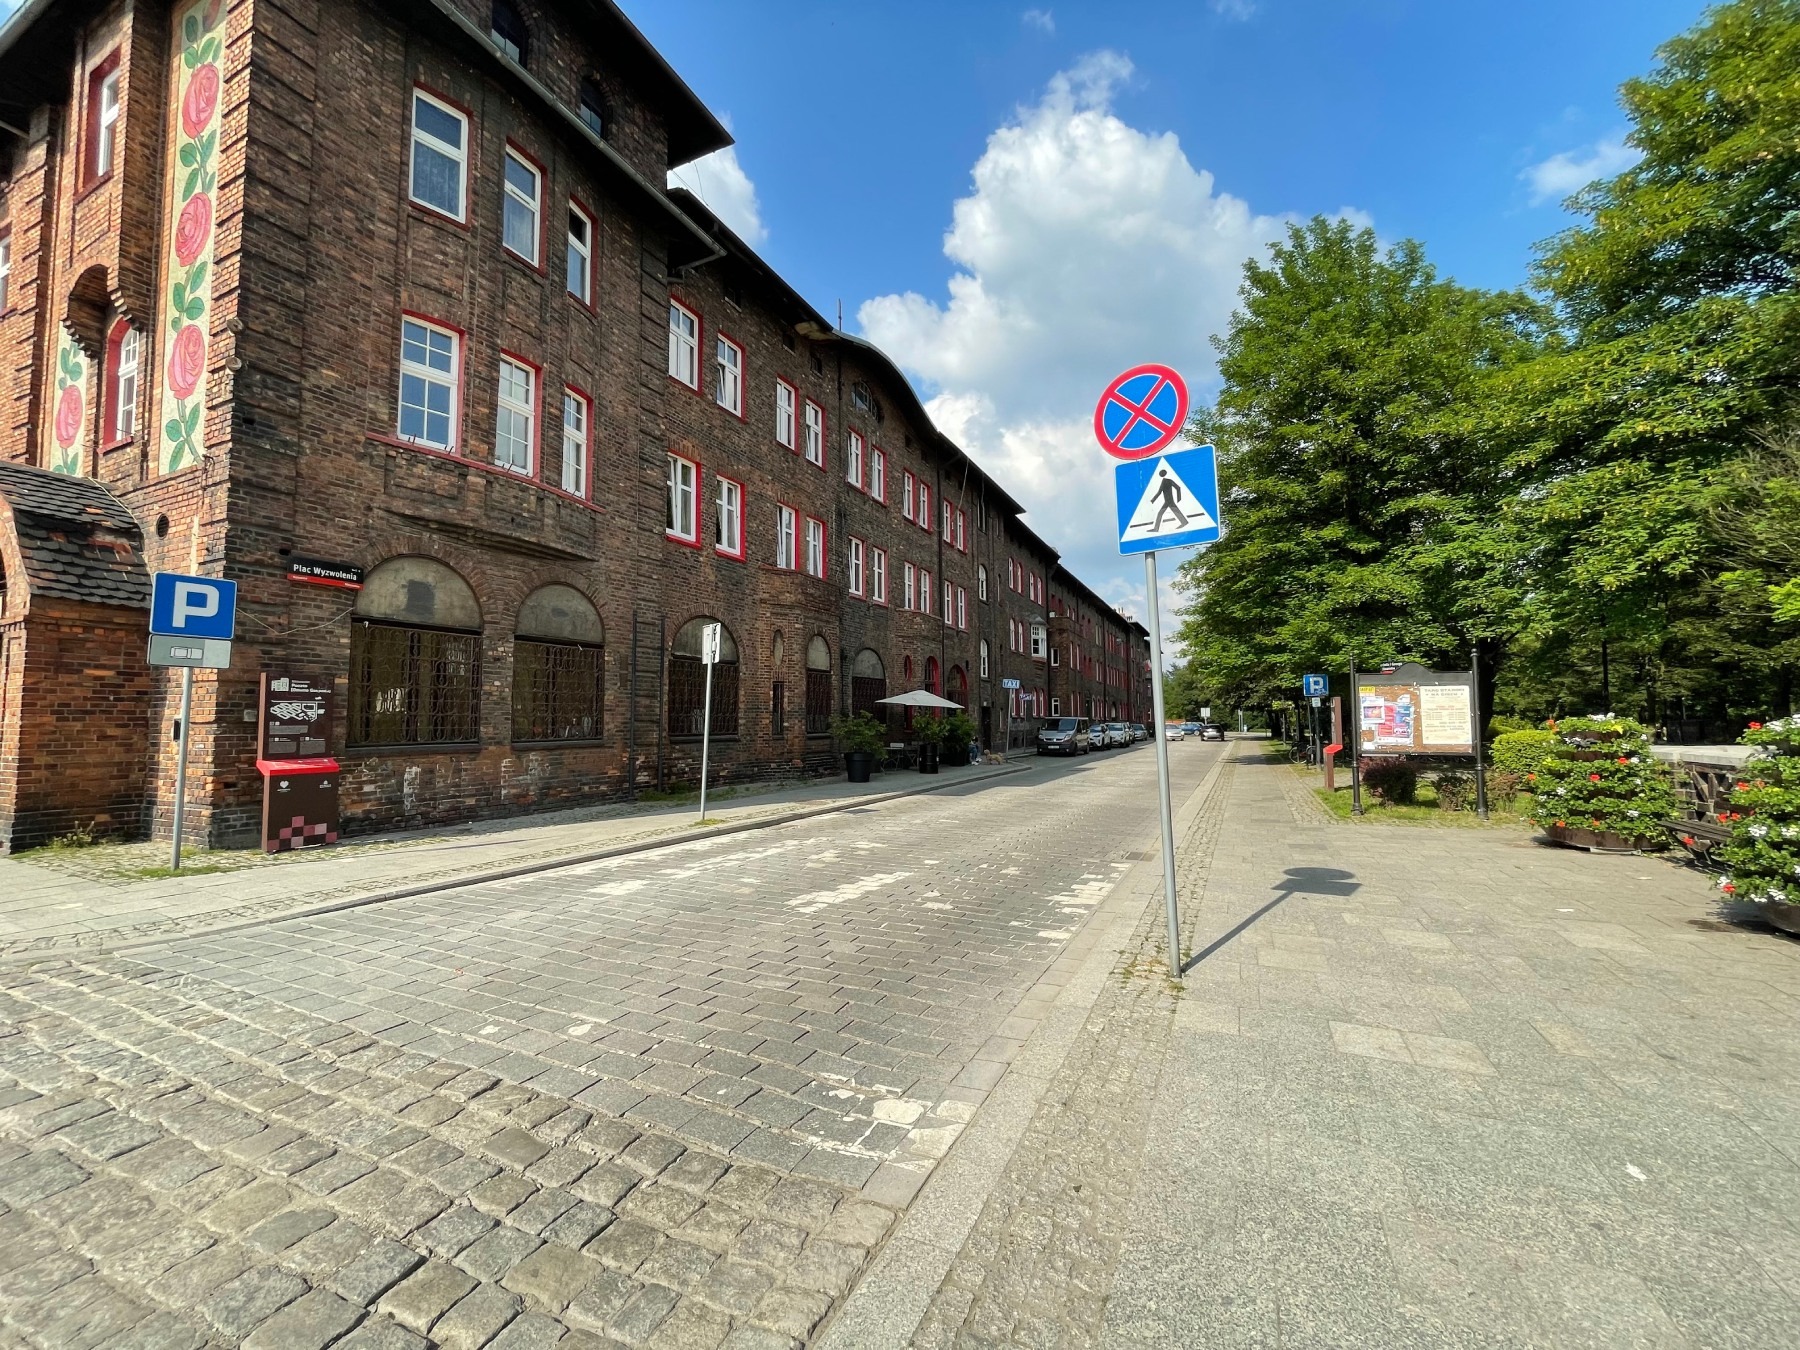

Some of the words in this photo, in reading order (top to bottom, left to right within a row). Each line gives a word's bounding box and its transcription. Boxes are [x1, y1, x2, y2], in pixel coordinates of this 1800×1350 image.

[293, 564, 312, 574] Plac
[313, 567, 357, 581] Wyzwolenia
[172, 581, 220, 628] P
[1004, 680, 1019, 688] TAXI
[1310, 677, 1324, 694] P
